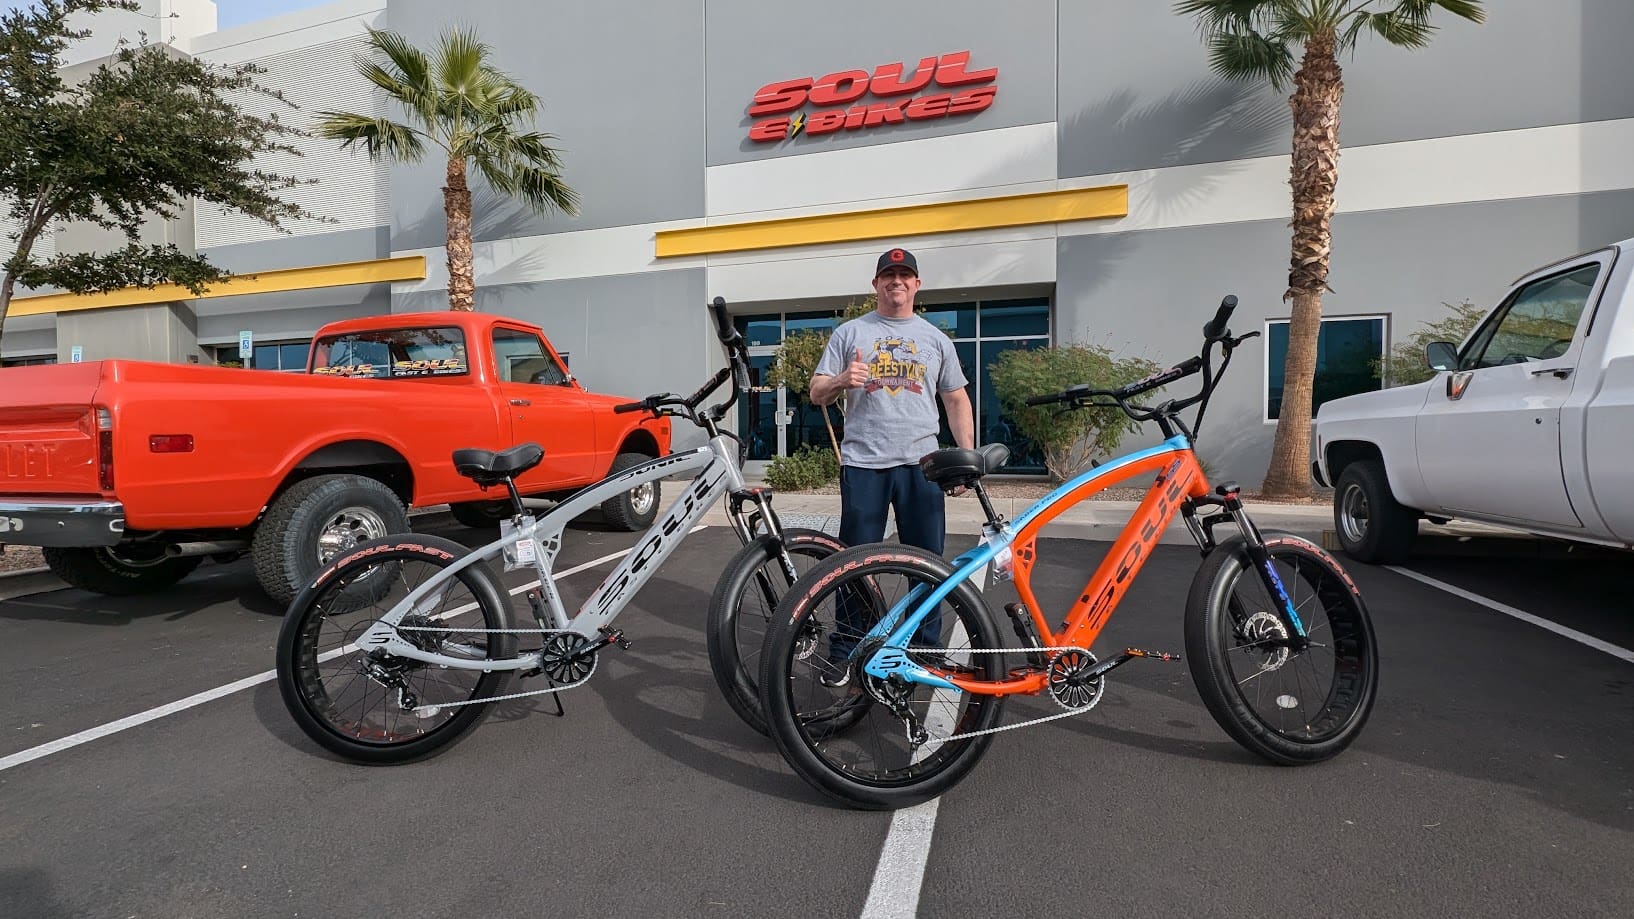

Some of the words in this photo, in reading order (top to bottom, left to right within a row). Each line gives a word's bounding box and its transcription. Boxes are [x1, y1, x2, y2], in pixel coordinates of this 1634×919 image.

[748, 50, 998, 118] SOUL
[749, 117, 791, 143] E
[806, 86, 998, 136] BIKES
[598, 470, 726, 615] SOUL
[1087, 469, 1194, 630] SOUL
[809, 560, 864, 598] SOUL
